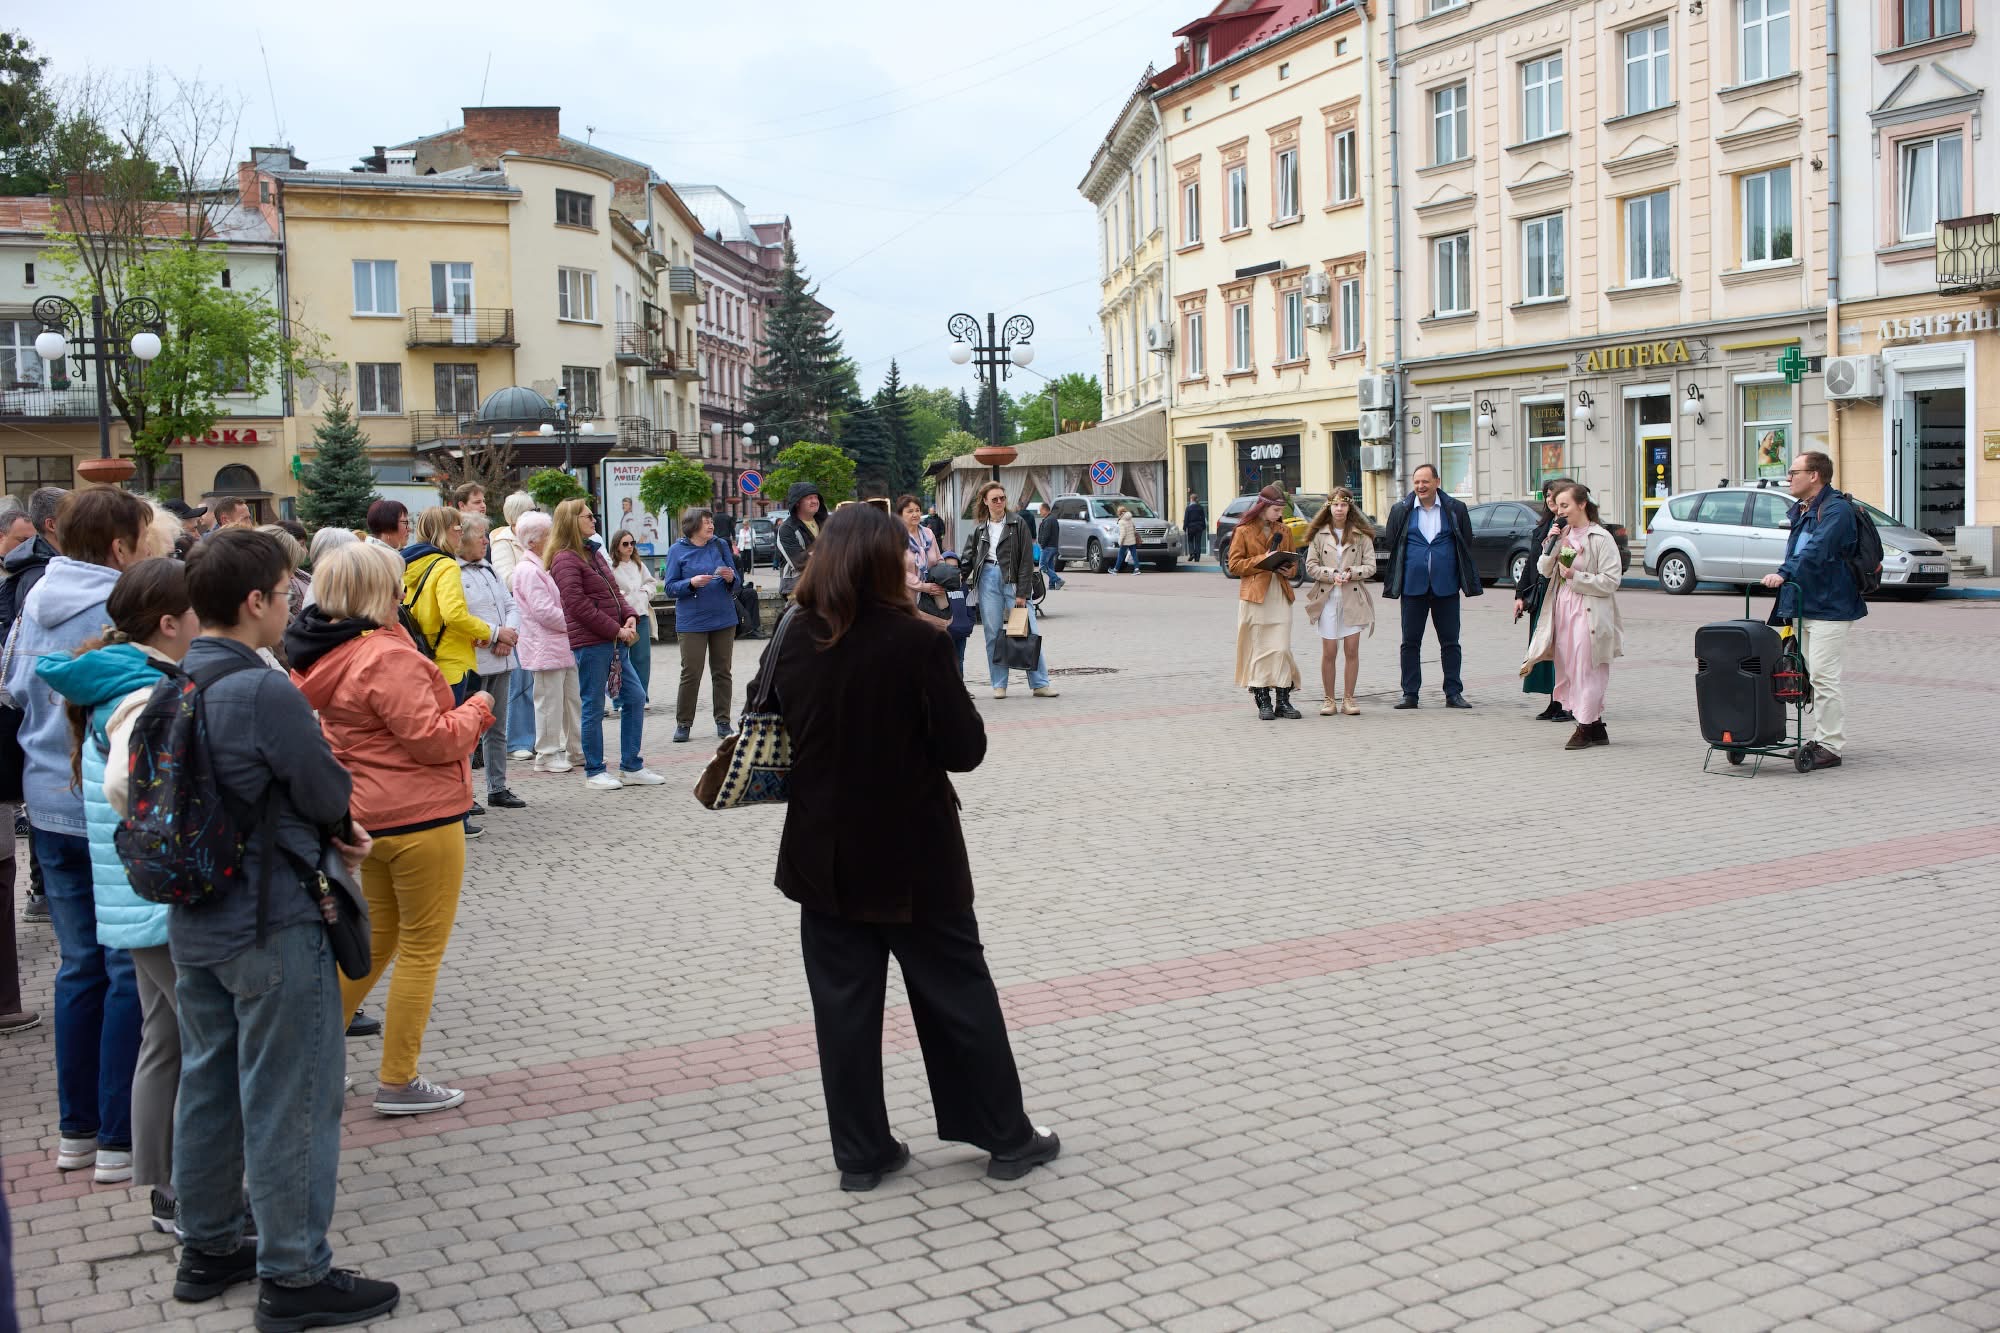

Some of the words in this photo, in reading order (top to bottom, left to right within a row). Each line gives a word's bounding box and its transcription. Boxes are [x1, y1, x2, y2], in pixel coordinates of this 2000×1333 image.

[1878, 309, 2000, 340] ЛЬВІВ'ЯН
[1586, 339, 1689, 371] АПТЕКА
[1412, 417, 1420, 426] 19
